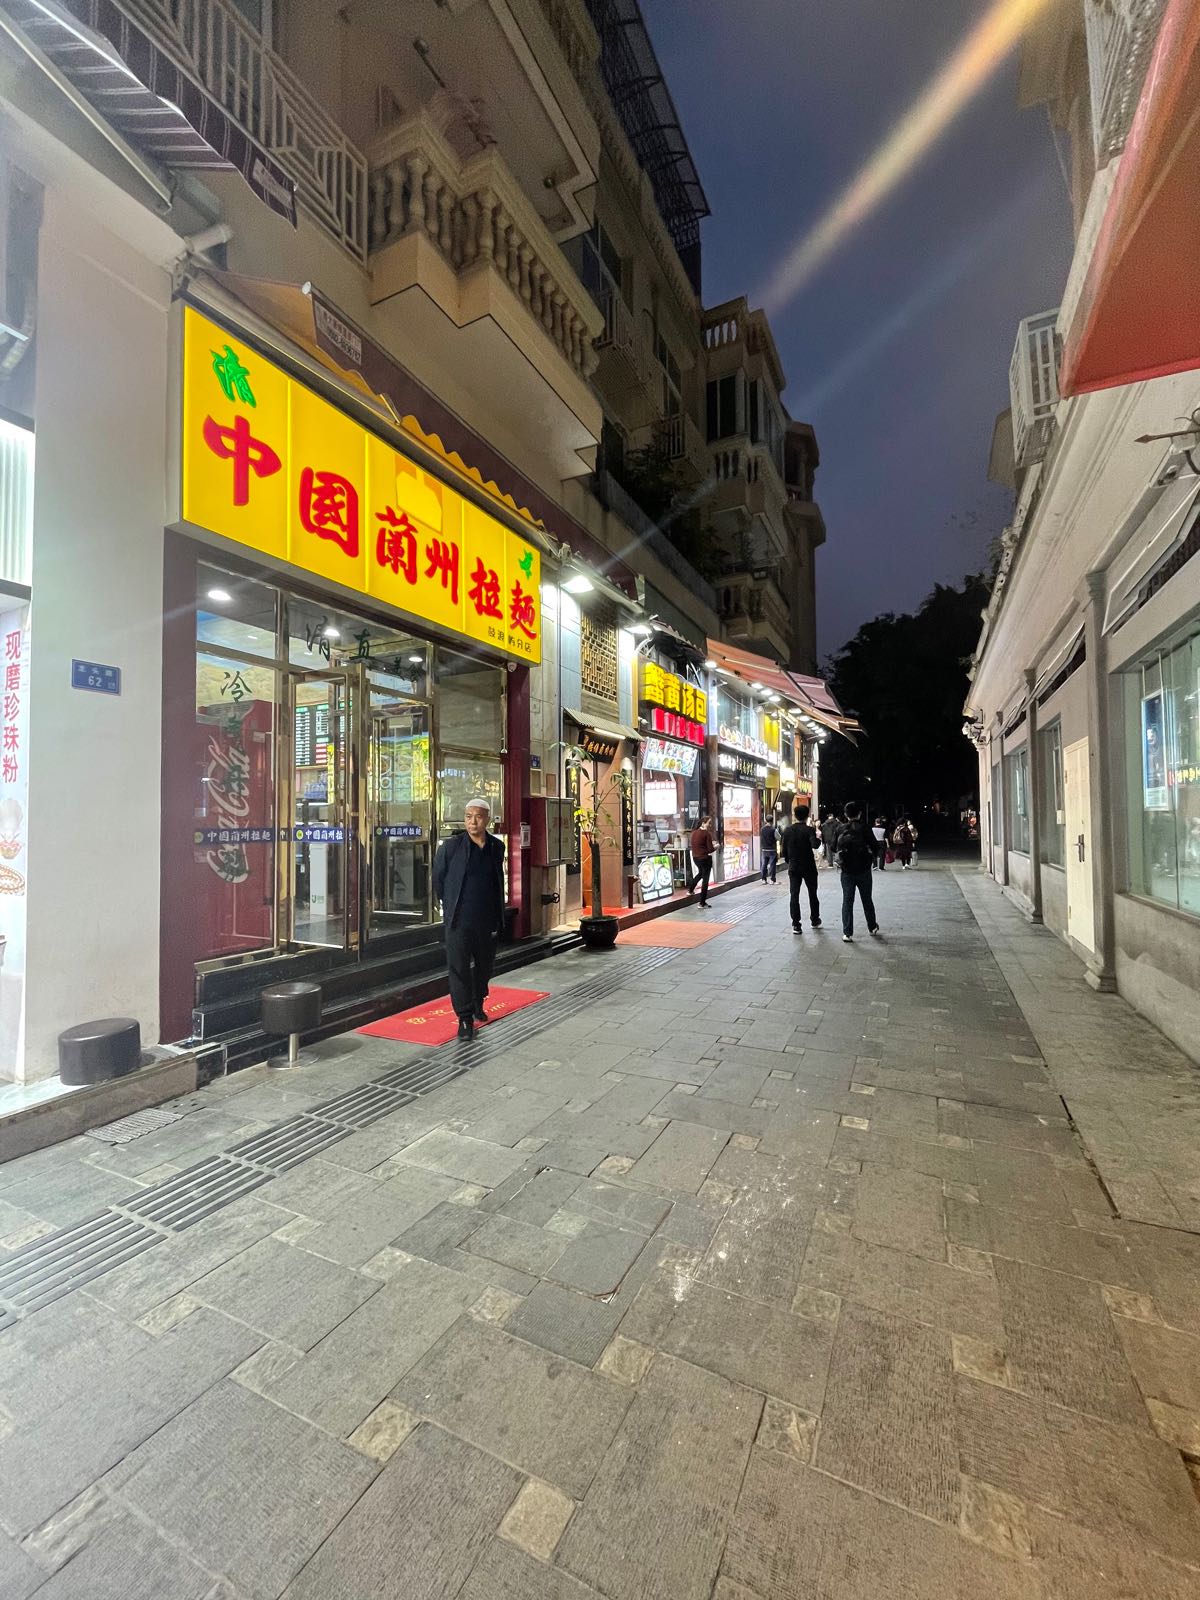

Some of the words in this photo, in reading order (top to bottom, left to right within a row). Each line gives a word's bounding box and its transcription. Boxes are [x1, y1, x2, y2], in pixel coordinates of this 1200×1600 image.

[2, 630, 22, 784] 现磨珍珠粉
[88, 675, 102, 687] 62
